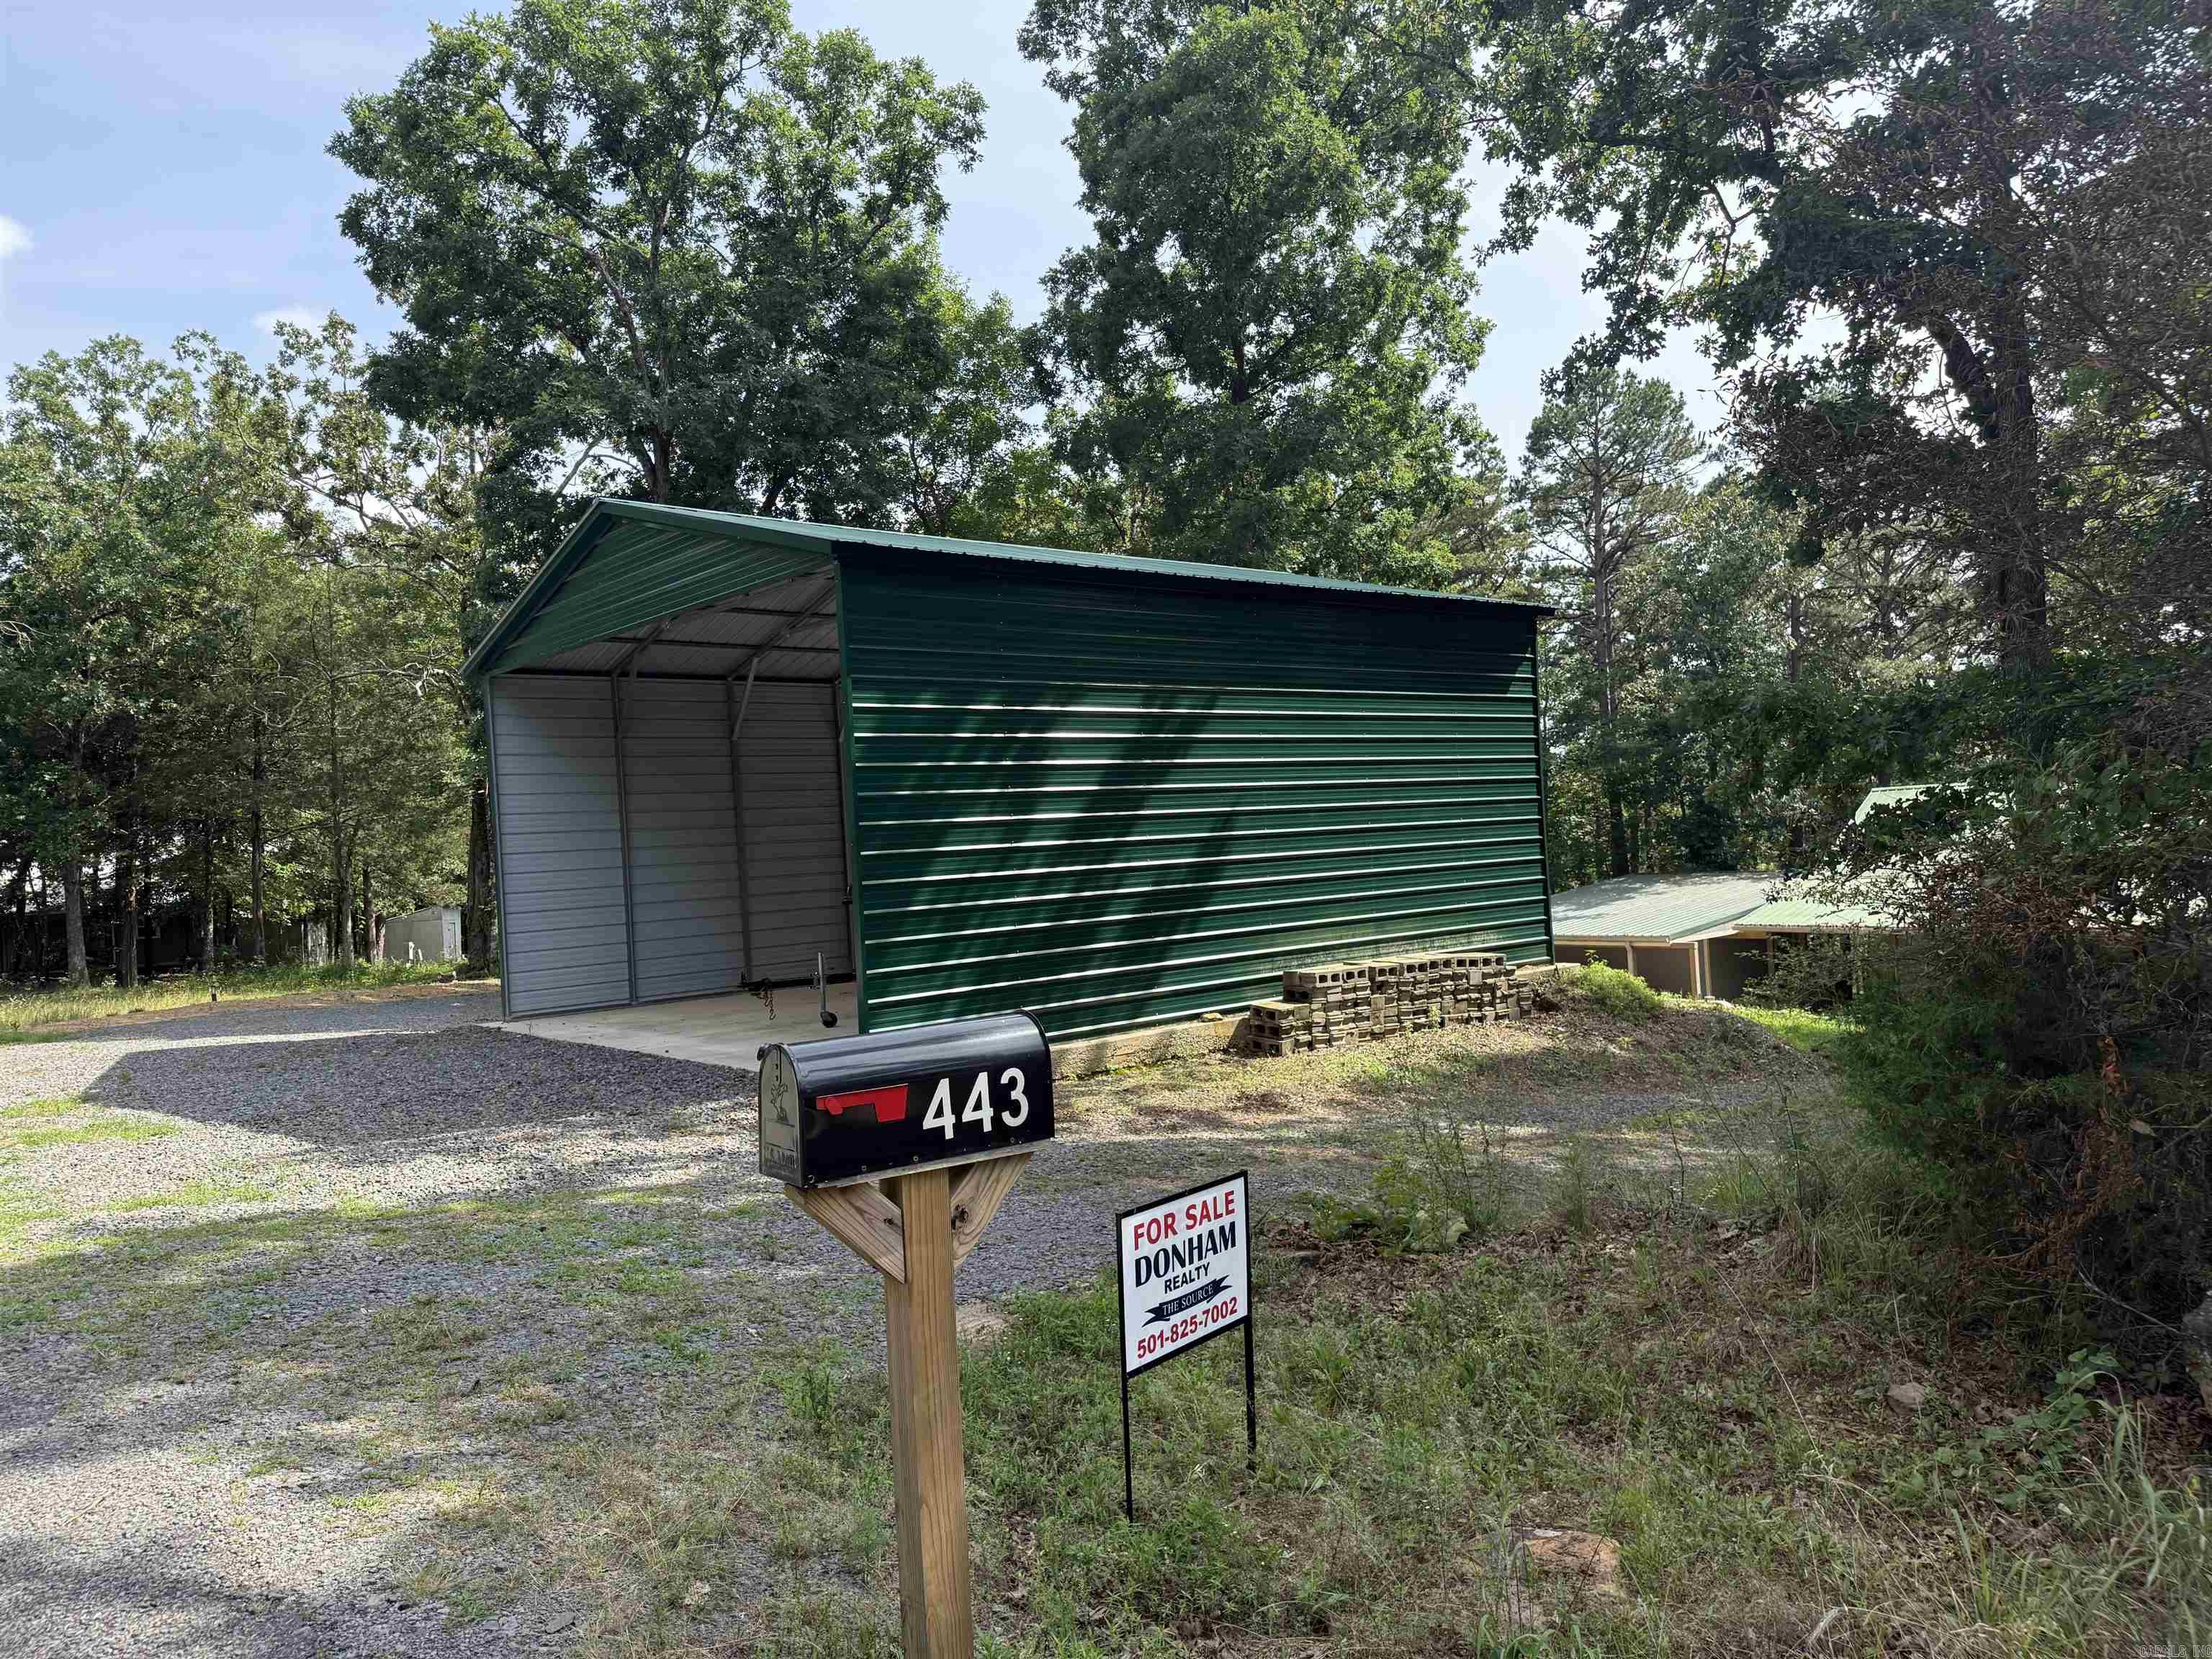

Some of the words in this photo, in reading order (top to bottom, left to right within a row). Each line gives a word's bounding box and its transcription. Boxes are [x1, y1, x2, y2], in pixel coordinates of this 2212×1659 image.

[922, 1067, 1029, 1140] 443
[1133, 1211, 1178, 1251] FOR
[1185, 1190, 1236, 1231] SALE
[1135, 1221, 1236, 1287] DONHAM
[1164, 1262, 1210, 1294] REALTY
[1137, 1297, 1238, 1359] 501-825-7002
[1162, 1300, 1179, 1316] THE
[1181, 1285, 1213, 1308] SOURCE
